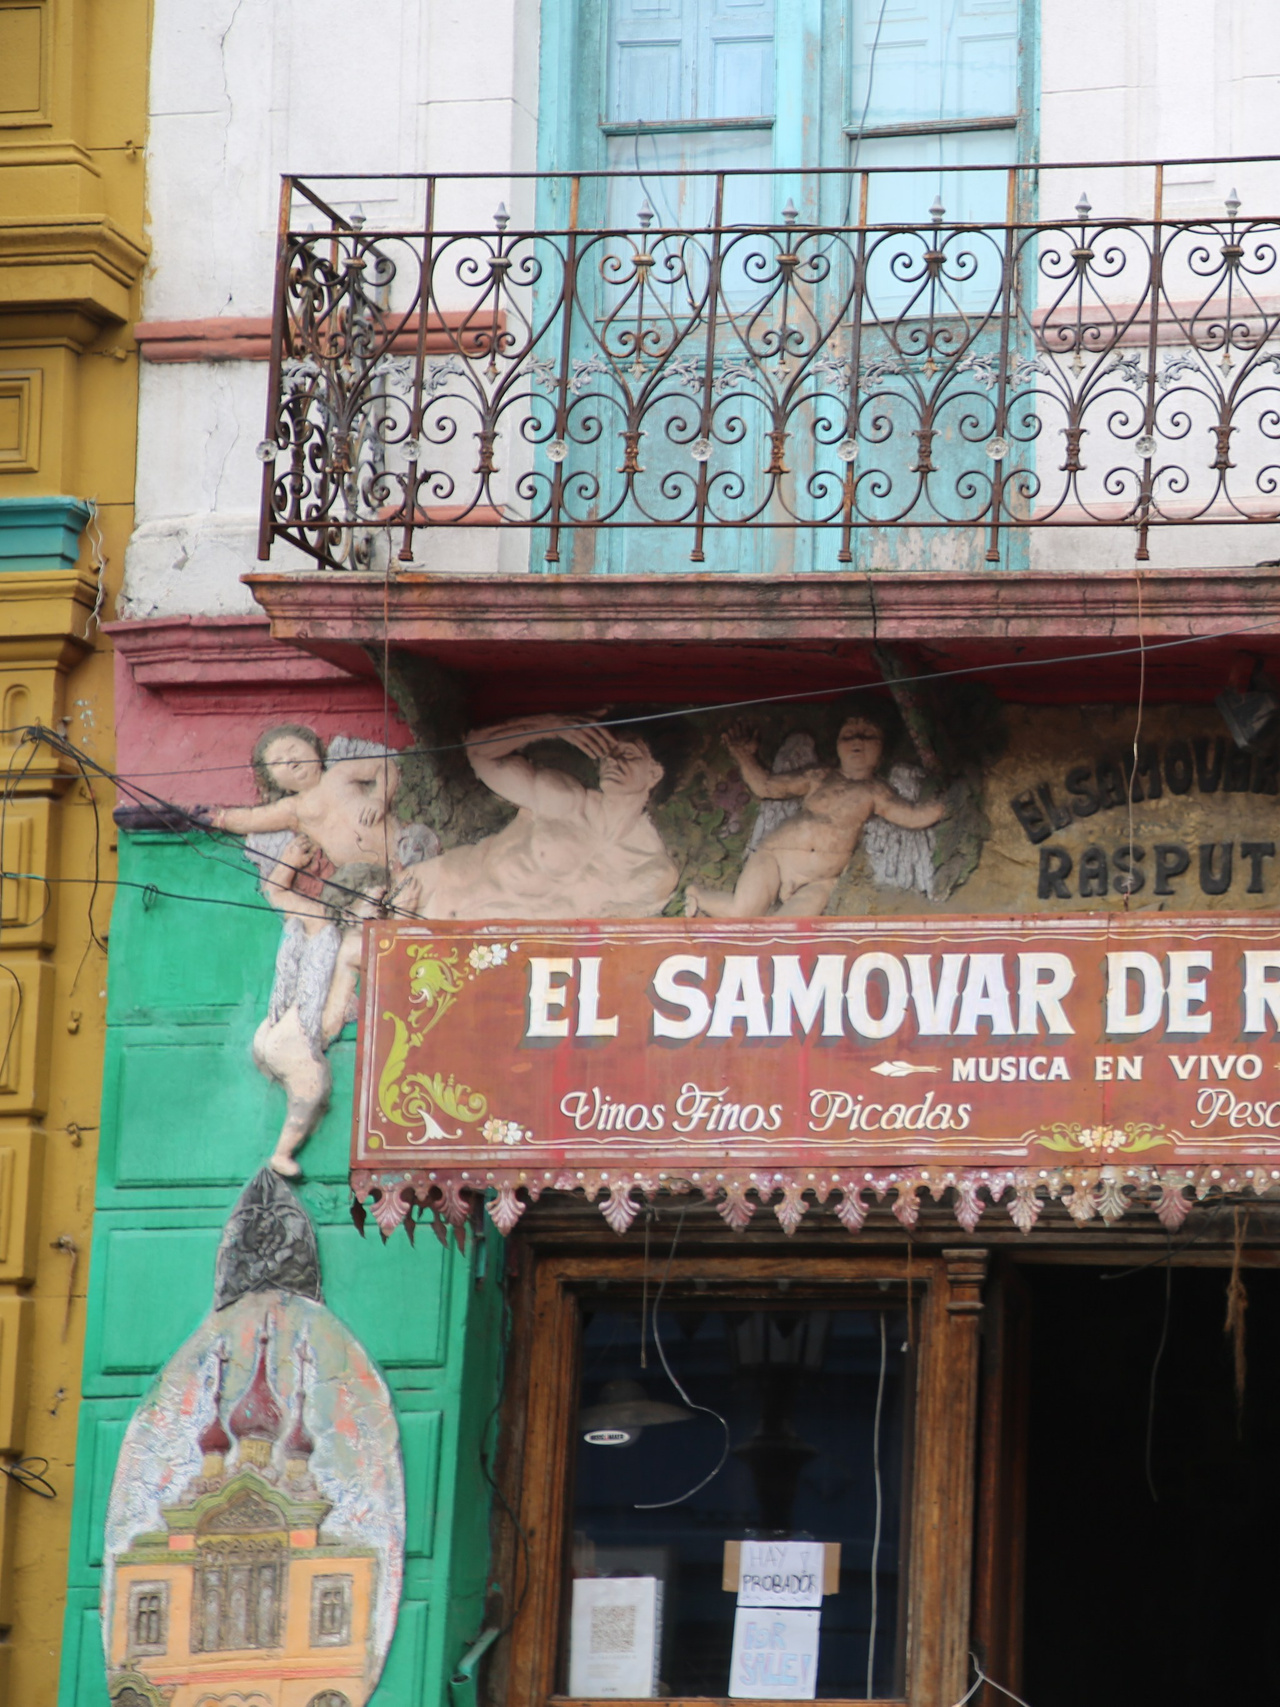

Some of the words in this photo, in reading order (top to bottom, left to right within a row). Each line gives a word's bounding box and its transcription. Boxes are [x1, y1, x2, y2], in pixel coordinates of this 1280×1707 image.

[1011, 785, 1070, 843] EL
[1066, 740, 1279, 816] SAMOVAR
[526, 956, 619, 1037] EL
[652, 951, 1075, 1038] SAMOVAR
[1104, 951, 1213, 1034] DE
[953, 1056, 1071, 1082] MUSICA
[1094, 1055, 1144, 1081] EN
[1169, 1054, 1263, 1081] VIVO
[560, 1087, 665, 1132] Vinos
[672, 1083, 783, 1132] Finos
[809, 1090, 971, 1132] Picadas
